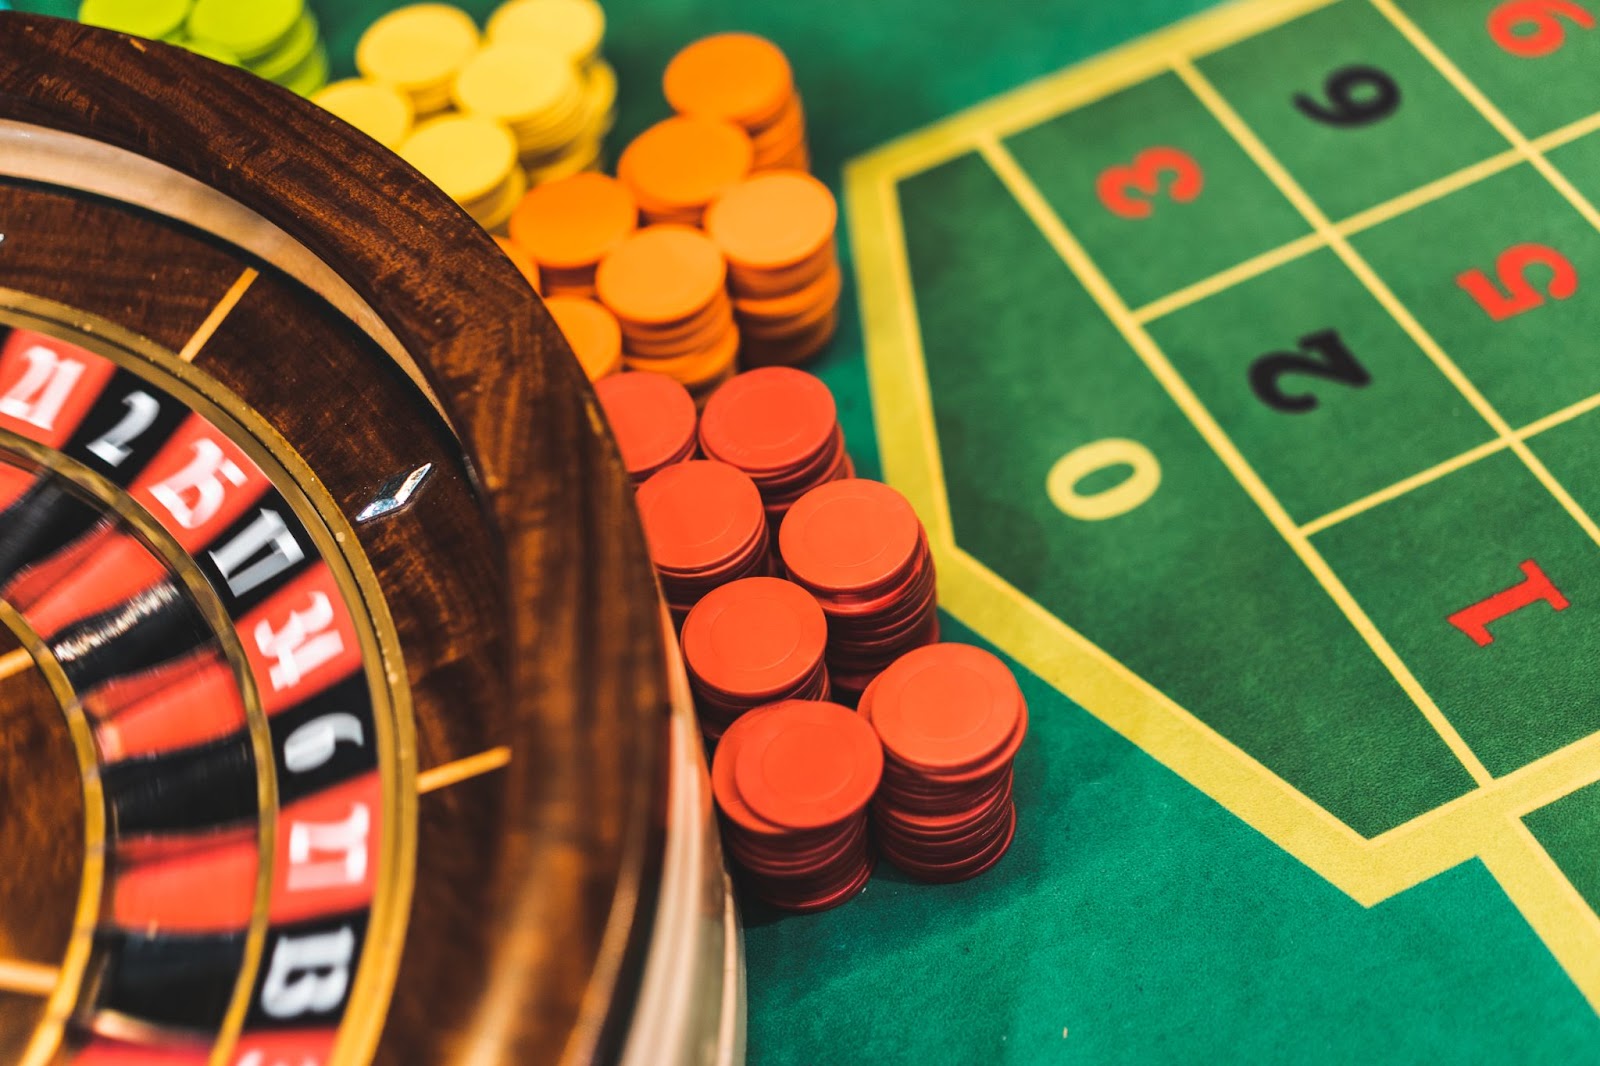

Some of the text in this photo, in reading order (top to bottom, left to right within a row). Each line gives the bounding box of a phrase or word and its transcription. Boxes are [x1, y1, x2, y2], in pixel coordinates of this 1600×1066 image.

[1486, 0, 1597, 58] 9
[1292, 64, 1402, 129] 6
[1095, 146, 1204, 220] 3
[1456, 242, 1578, 322] 5
[0, 345, 86, 432] 21
[1247, 328, 1373, 415] 2
[86, 389, 161, 468] 2
[149, 438, 249, 530] 25
[1046, 438, 1162, 521] 0
[207, 507, 305, 598] 17
[253, 591, 345, 692] 34
[1446, 558, 1571, 648] 1
[283, 712, 365, 774] 6
[261, 924, 355, 1019] 13
